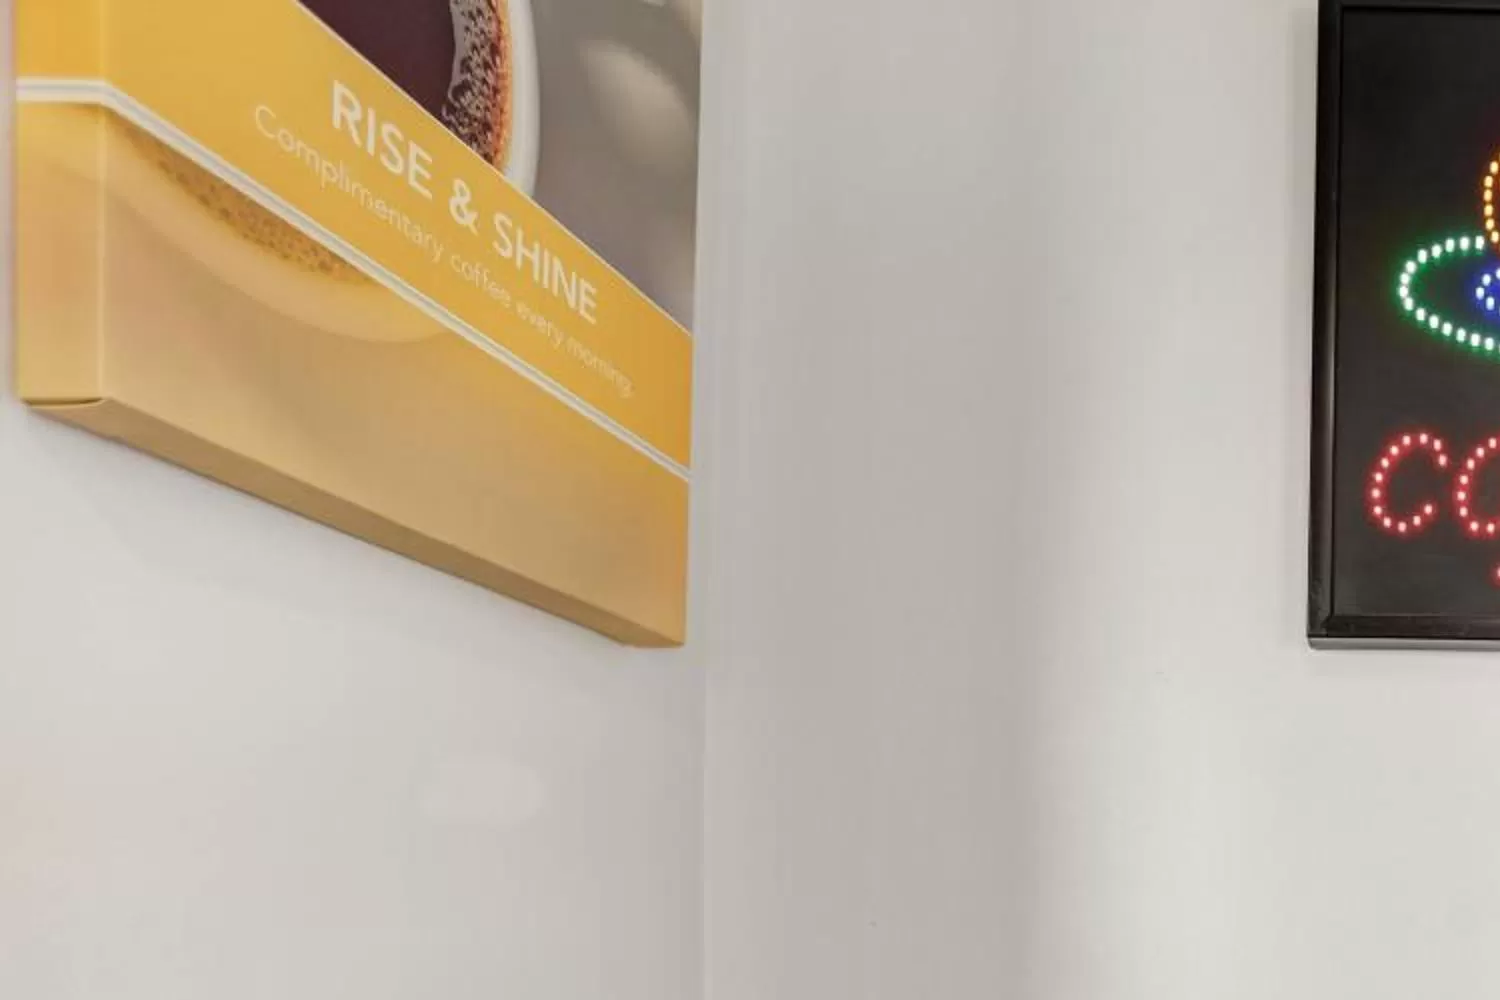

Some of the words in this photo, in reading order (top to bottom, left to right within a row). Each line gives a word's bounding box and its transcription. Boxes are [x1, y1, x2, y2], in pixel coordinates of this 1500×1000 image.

[255, 105, 445, 264] Complimentary
[451, 254, 512, 309] coffee
[515, 301, 565, 350] every
[332, 79, 433, 201] RISE
[448, 177, 480, 237] &
[492, 212, 598, 326] SHINE
